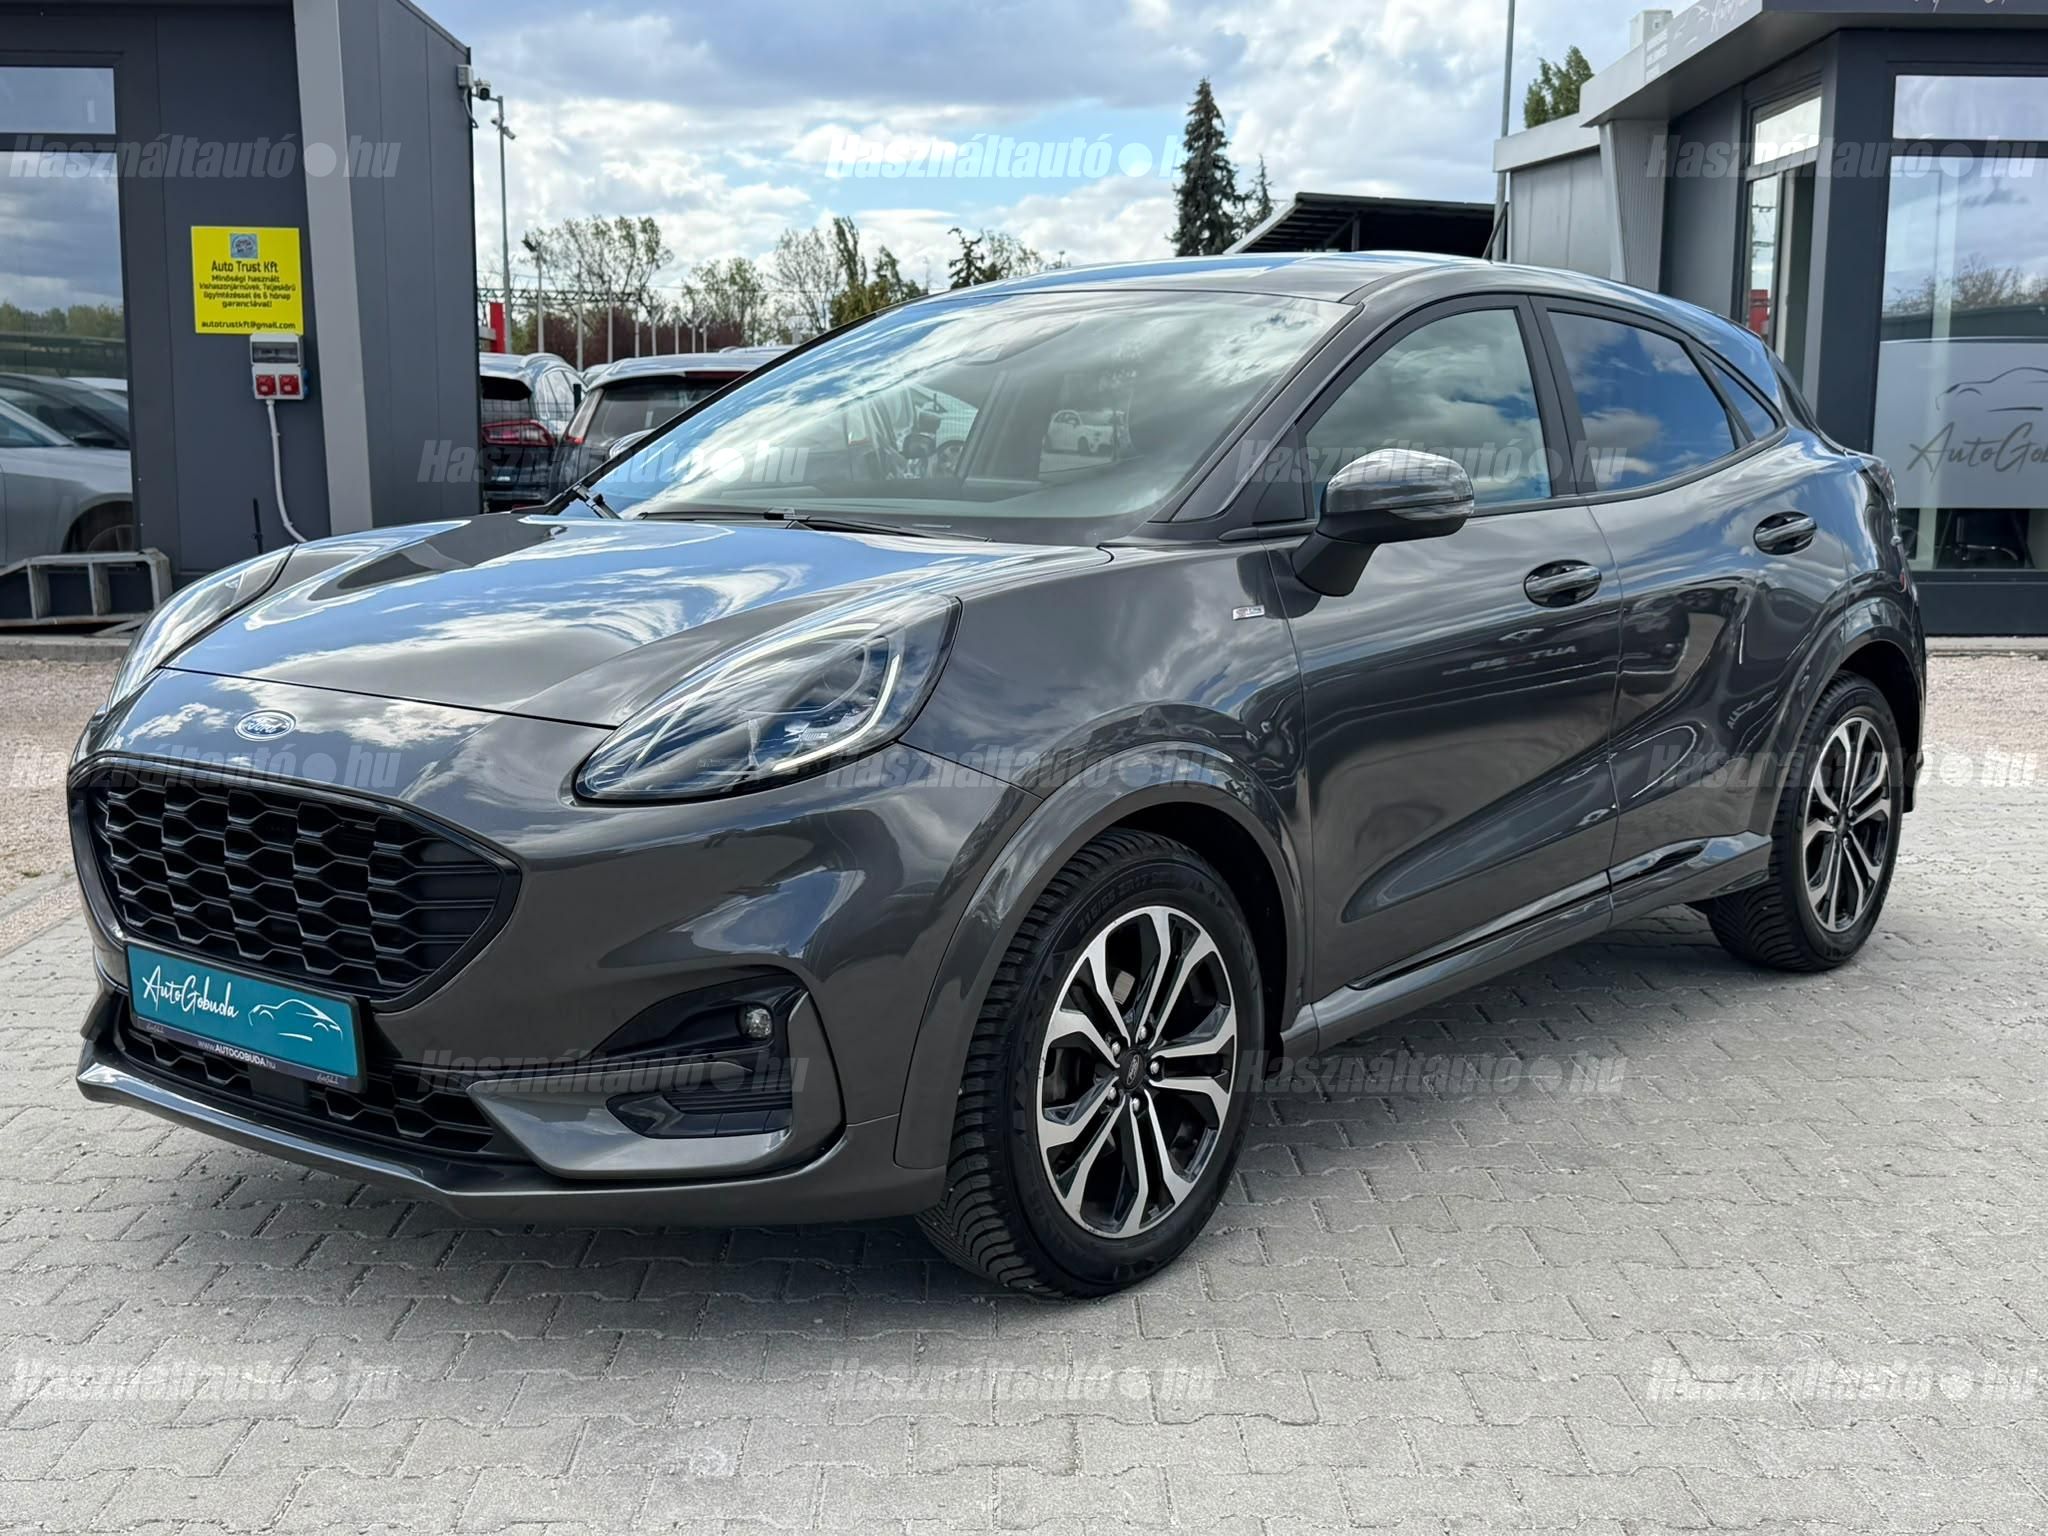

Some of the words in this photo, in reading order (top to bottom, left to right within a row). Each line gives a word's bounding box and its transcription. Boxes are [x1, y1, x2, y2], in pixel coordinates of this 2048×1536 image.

[211, 260, 233, 272] Auto
[236, 260, 261, 272] Trust
[263, 260, 278, 272] Kft
[142, 965, 239, 1018] AutoGobuda
